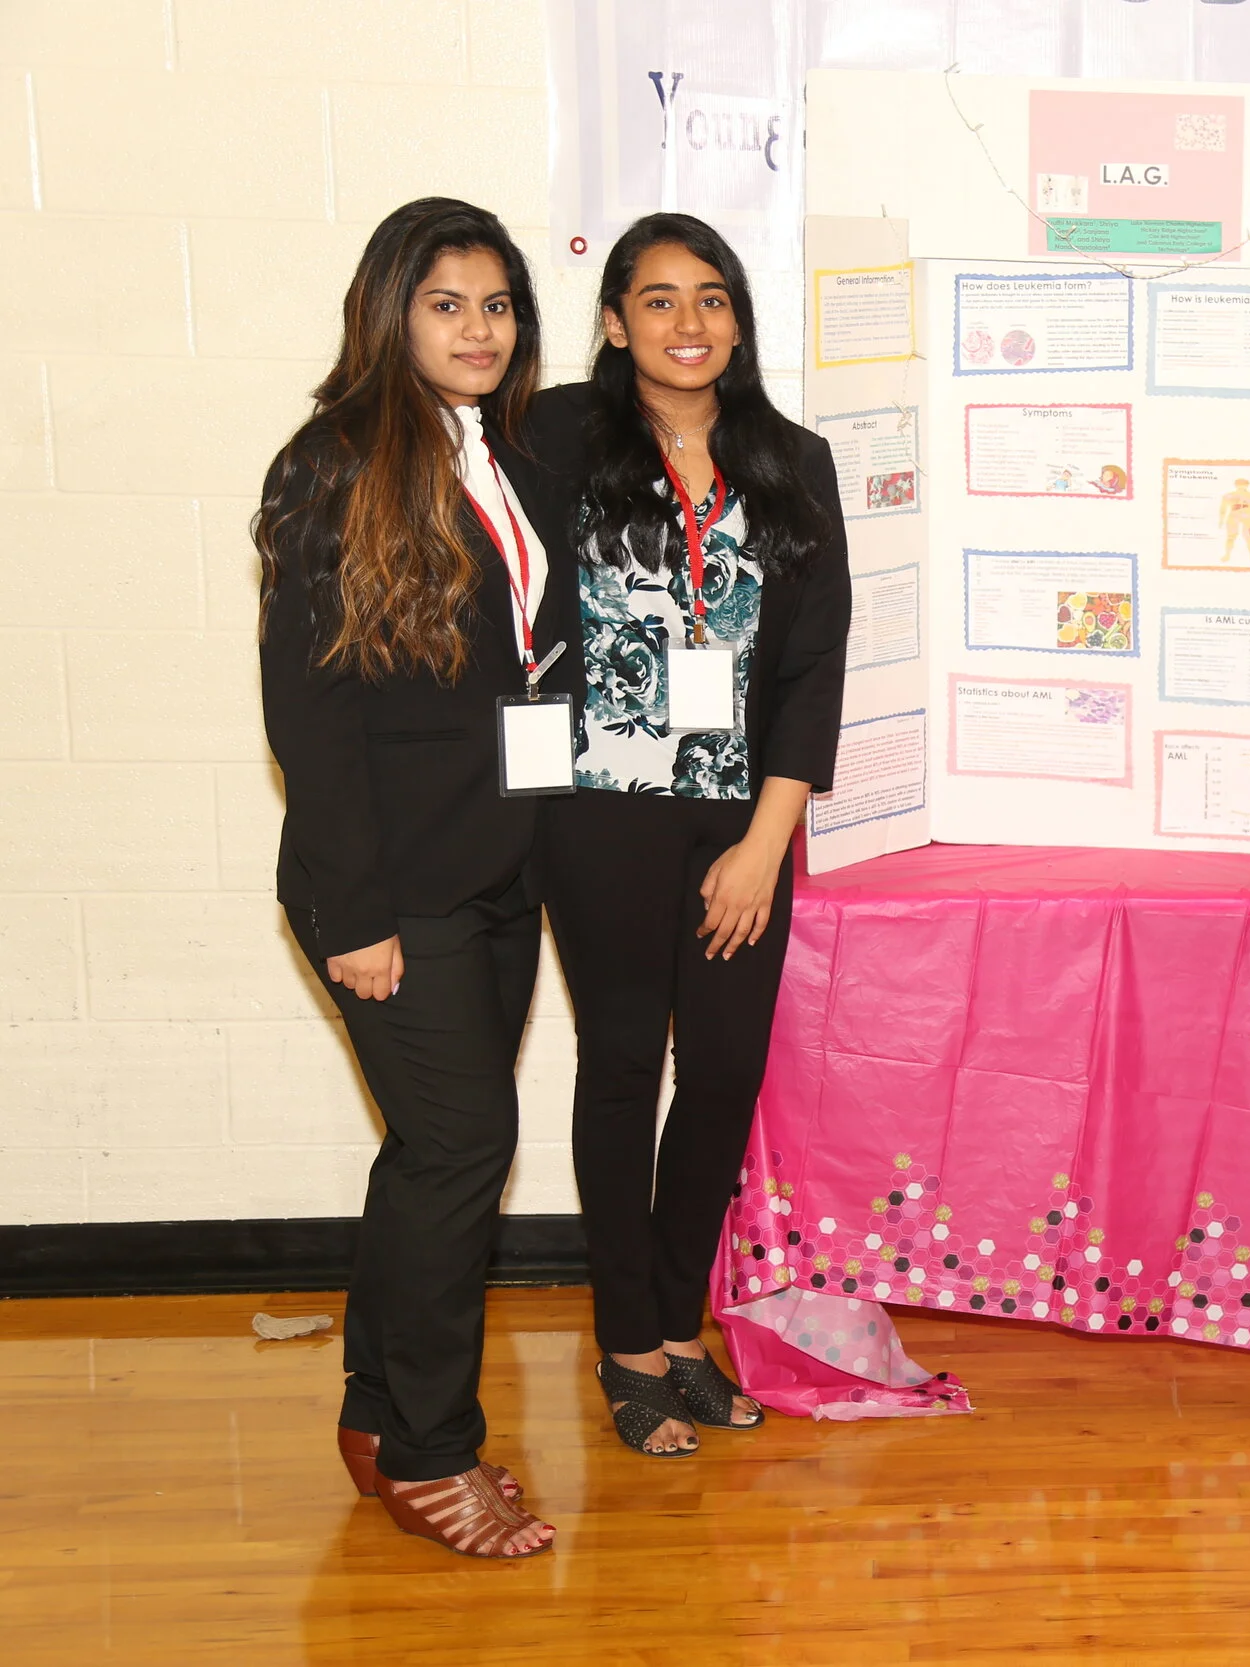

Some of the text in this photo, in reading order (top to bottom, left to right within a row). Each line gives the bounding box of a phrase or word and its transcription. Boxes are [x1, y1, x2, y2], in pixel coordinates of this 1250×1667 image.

[1102, 164, 1169, 186] L.A.G.
[836, 274, 895, 286] General Information
[962, 282, 983, 291] How
[986, 281, 1010, 291] does
[1013, 281, 1061, 291] Leukemia
[1064, 280, 1092, 291] form?
[1171, 295, 1192, 304] How
[1194, 295, 1202, 304] is
[1204, 295, 1250, 305] leukemia
[1022, 408, 1073, 418] Symptoms
[852, 420, 878, 431] Abstract
[1205, 615, 1213, 624] Is
[1215, 616, 1235, 624] AML
[958, 686, 1053, 700] Statistics about AML
[1168, 752, 1188, 760] AML
